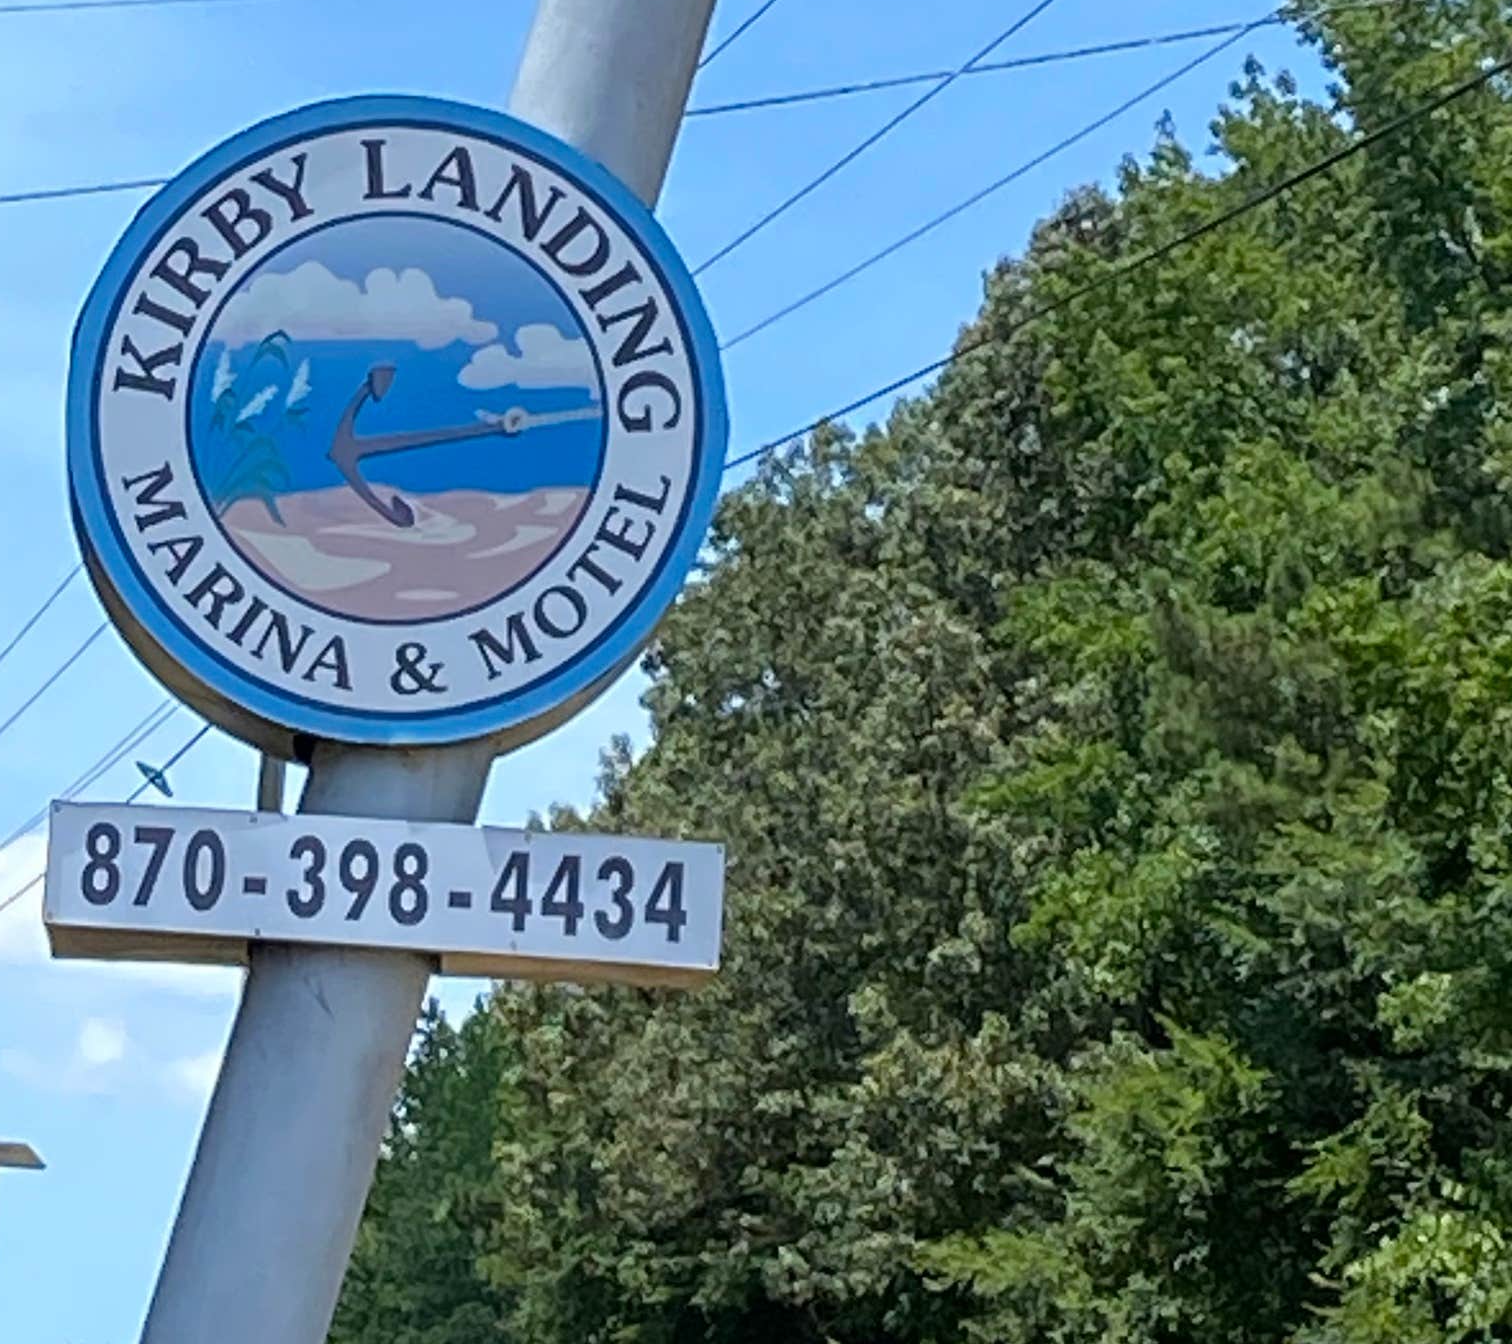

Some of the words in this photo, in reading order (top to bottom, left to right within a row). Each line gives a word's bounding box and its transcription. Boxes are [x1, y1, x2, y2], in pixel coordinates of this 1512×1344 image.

[112, 152, 315, 401] KIRBY
[359, 139, 683, 433] LANDING
[122, 461, 353, 692] MARINA
[389, 642, 448, 696] &
[467, 474, 672, 681] MOTEL
[80, 821, 688, 942] 870-398-4434
